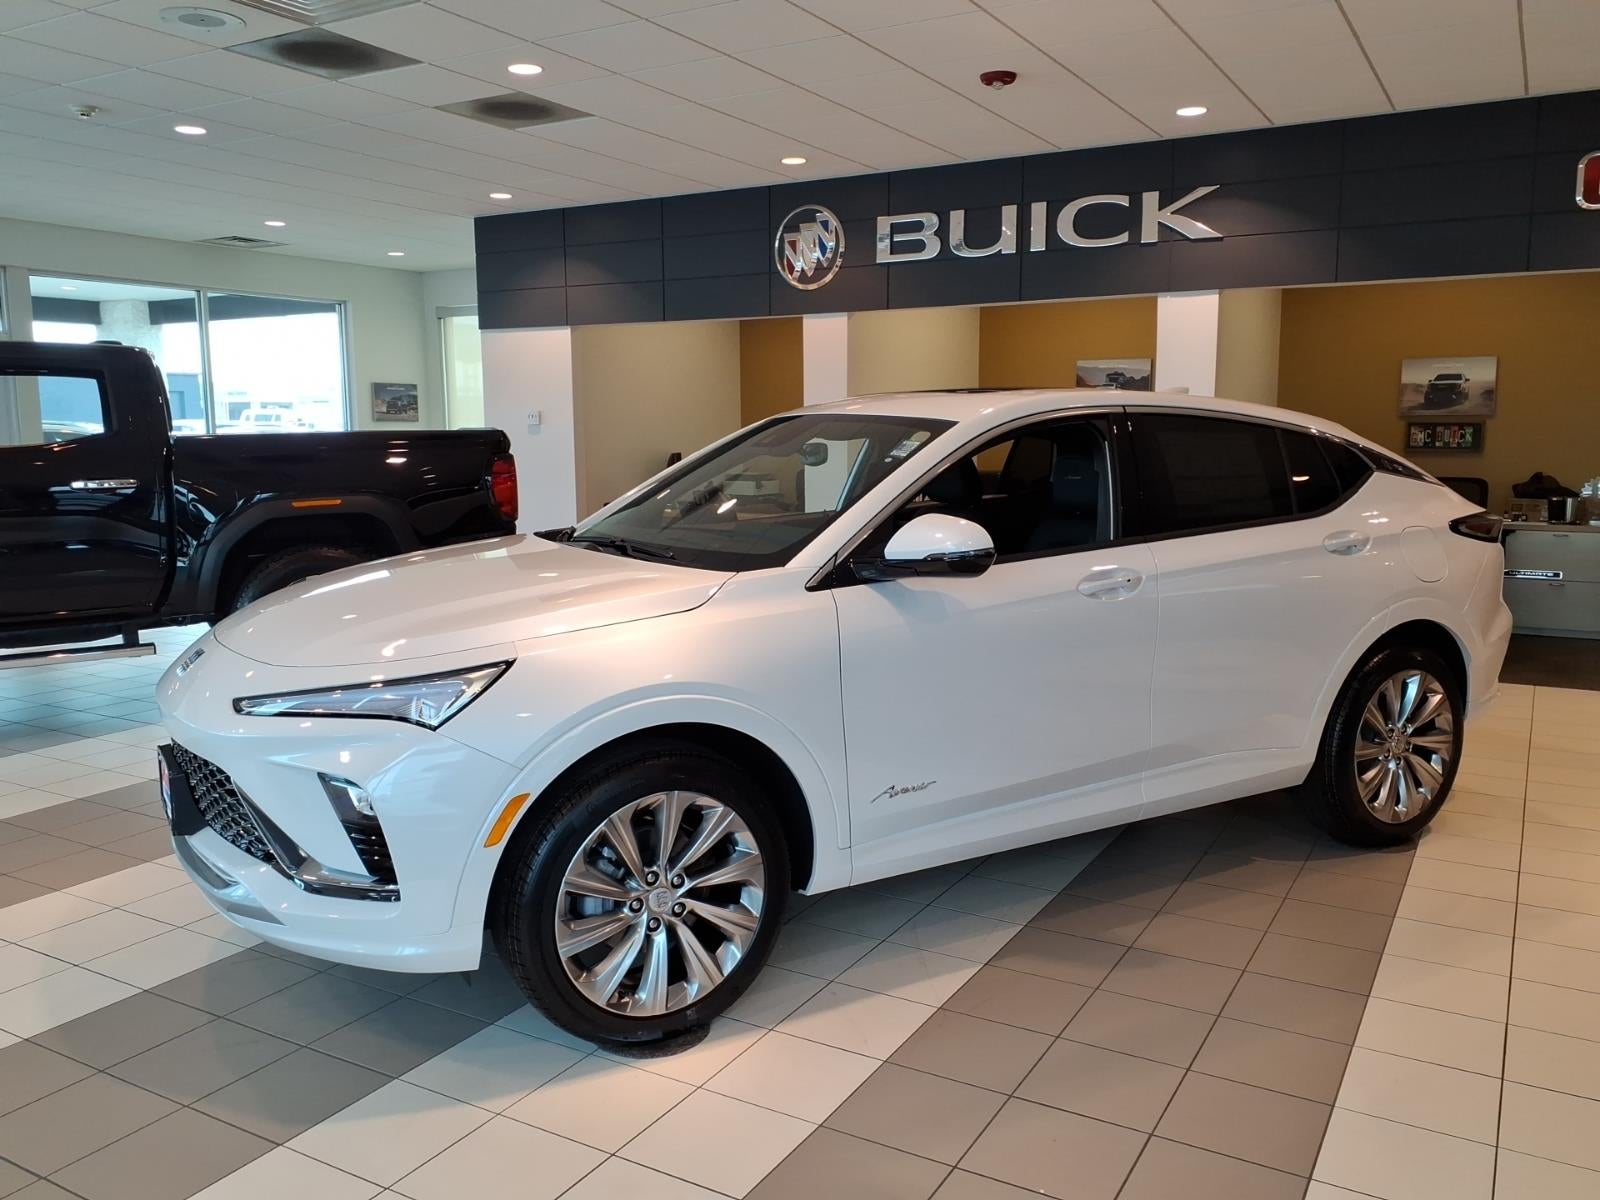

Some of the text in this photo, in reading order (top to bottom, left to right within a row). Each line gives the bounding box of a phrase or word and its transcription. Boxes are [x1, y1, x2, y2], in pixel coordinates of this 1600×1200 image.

[875, 184, 1224, 264] BUICK
[1410, 429, 1473, 443] GMC BUICK
